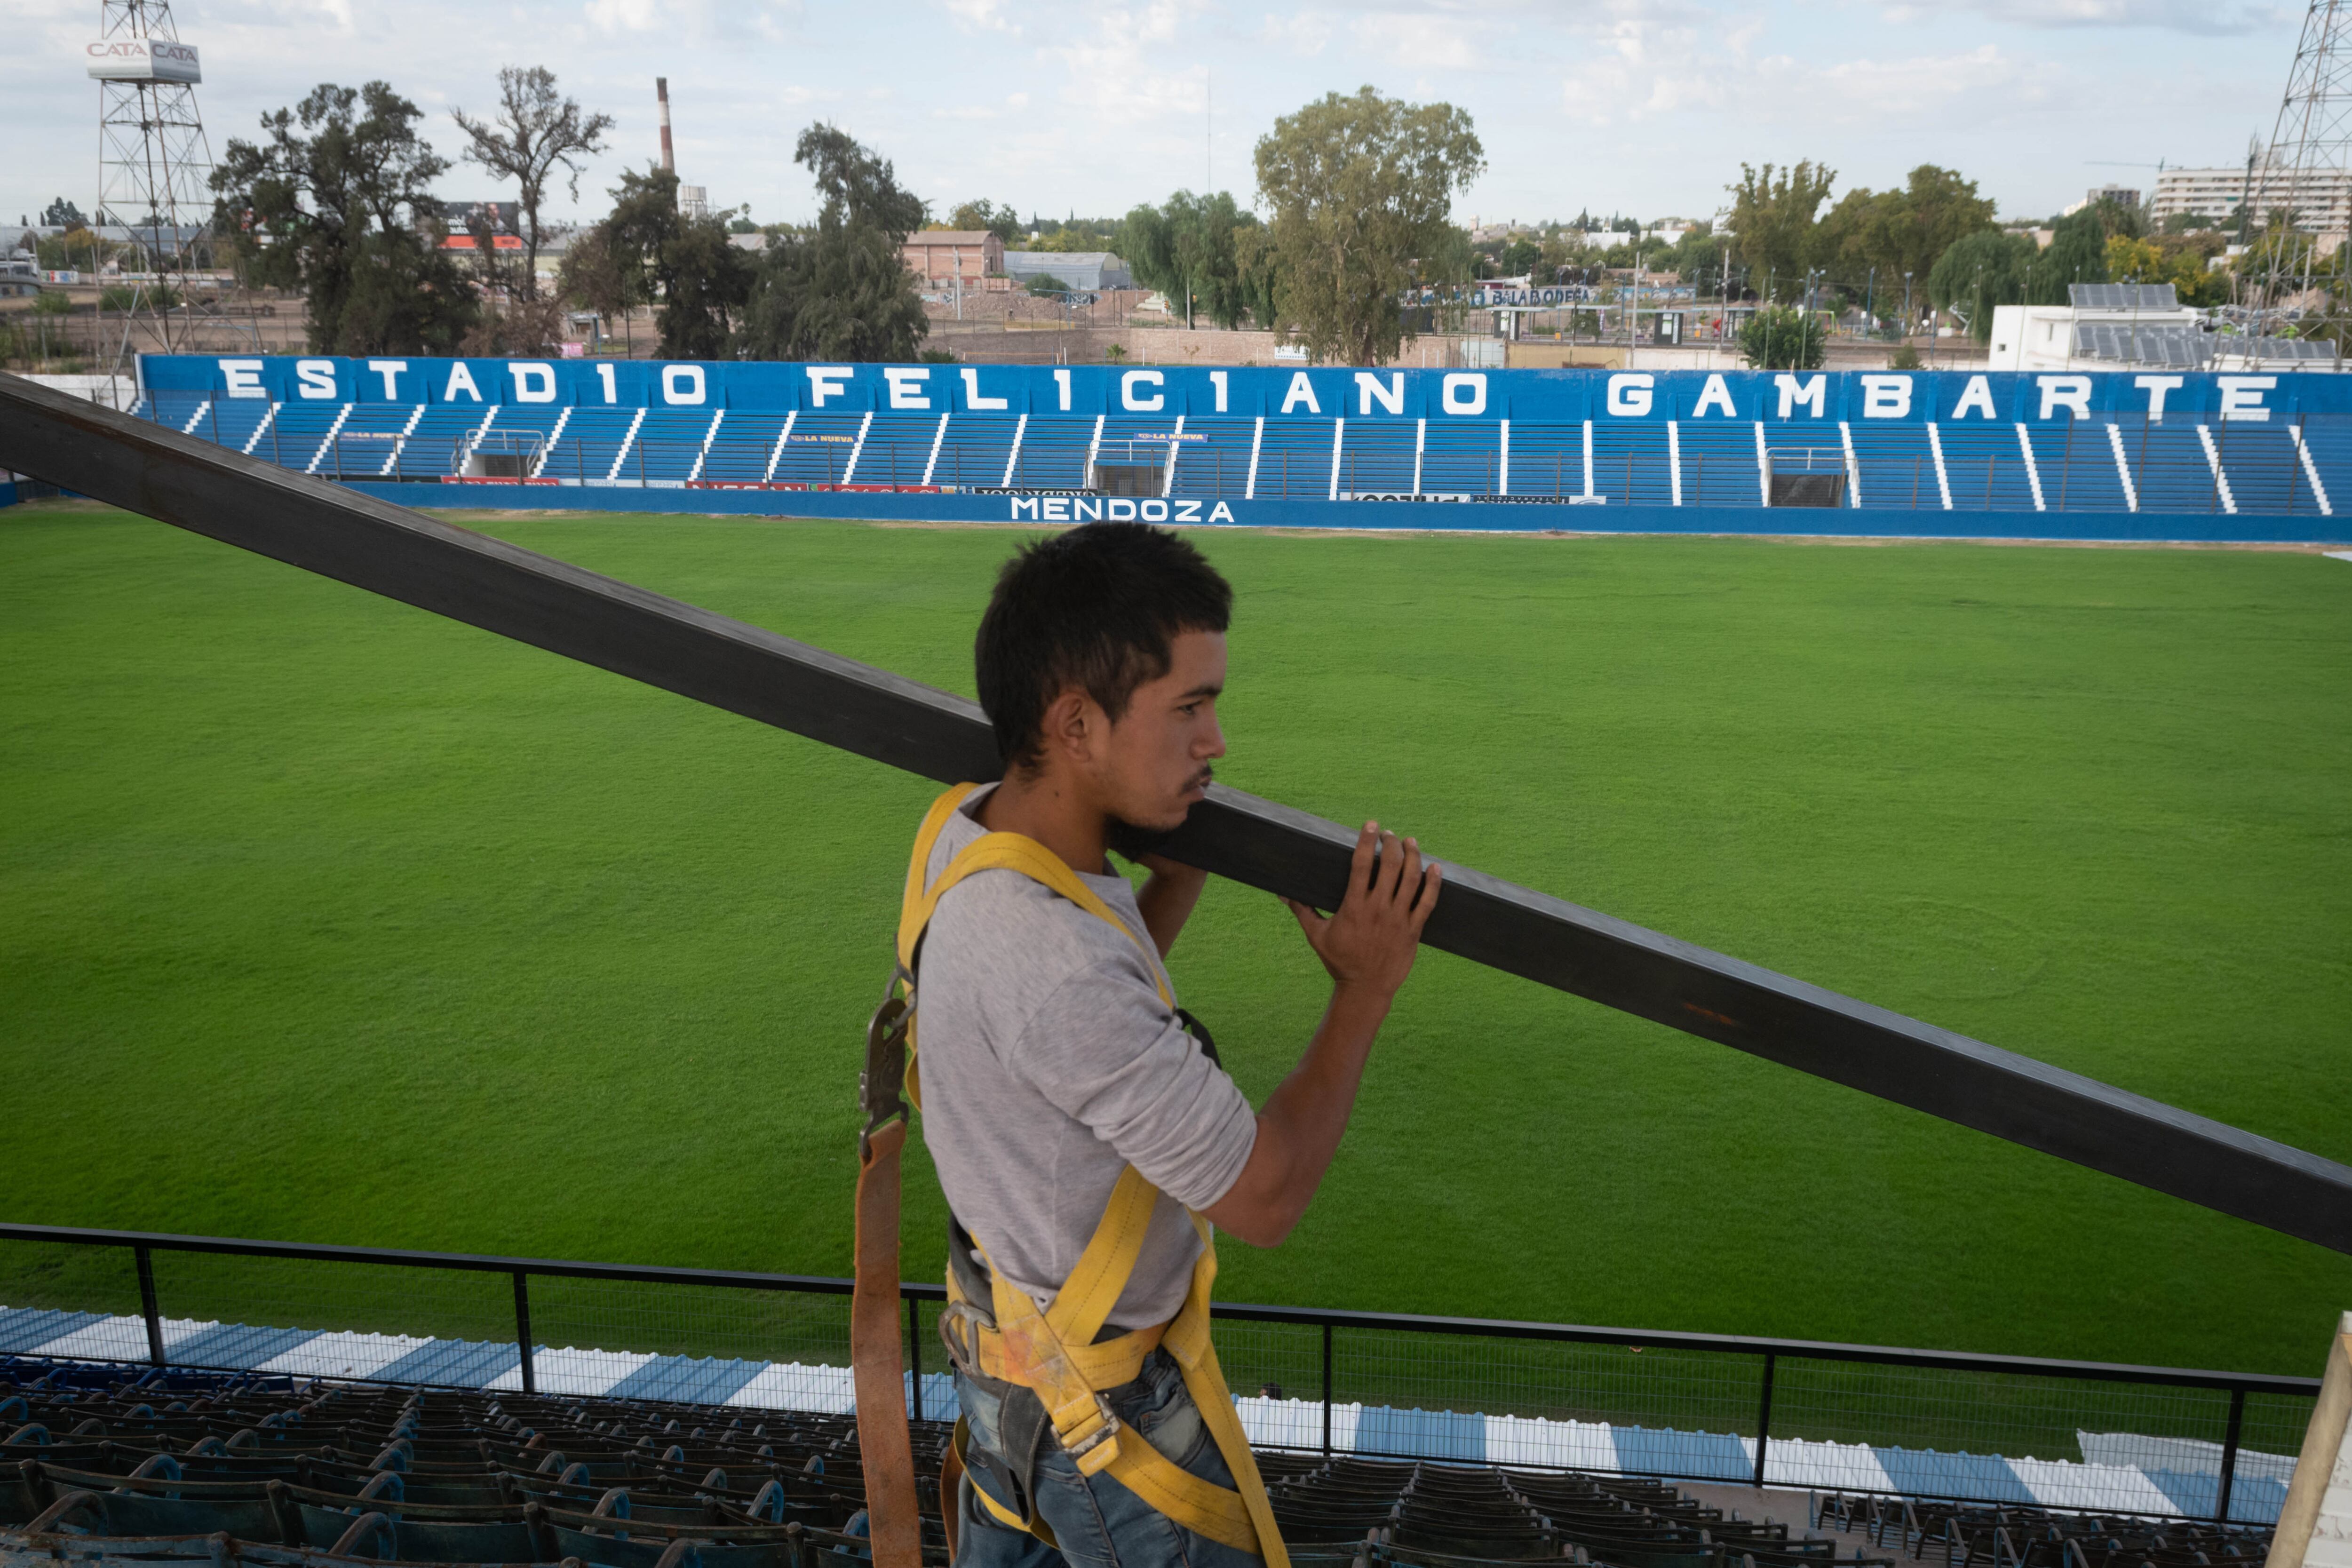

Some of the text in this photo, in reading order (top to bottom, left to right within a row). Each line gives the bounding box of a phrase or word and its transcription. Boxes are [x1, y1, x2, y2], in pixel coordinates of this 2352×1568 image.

[87, 43, 147, 56] CATA
[152, 43, 197, 63] CATA
[1511, 289, 1526, 305] LA
[1530, 288, 1589, 306] BODEGA
[218, 359, 2277, 421] ESTADIO FELICIANO GAMBARTE
[1011, 497, 1234, 523] MENDOZA
